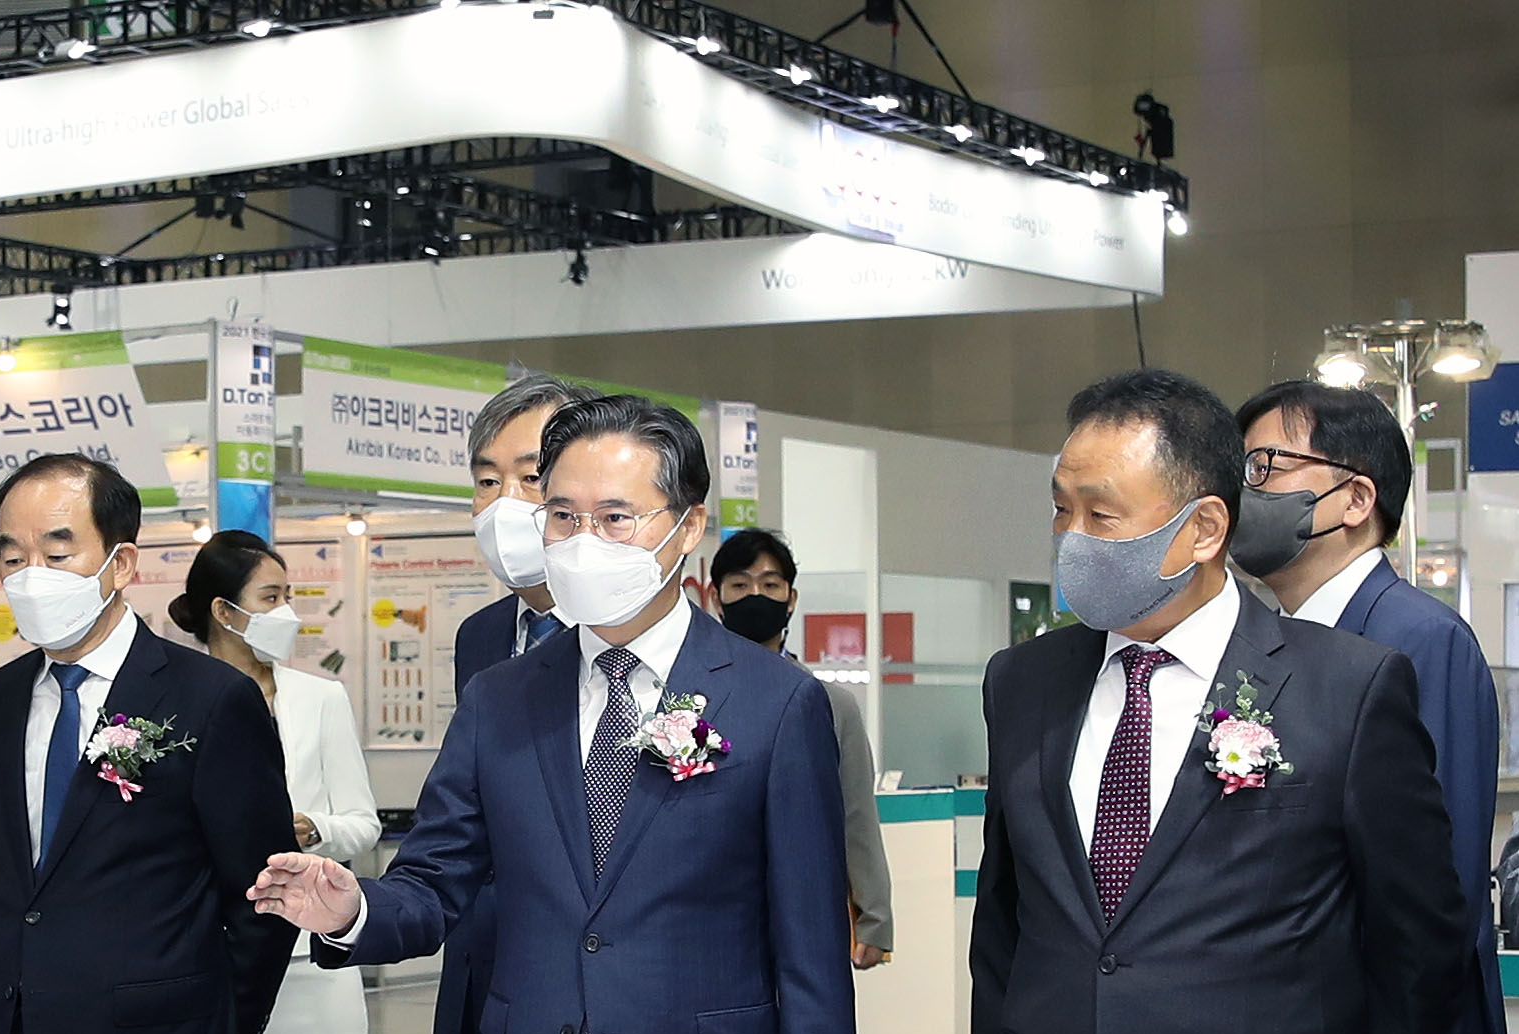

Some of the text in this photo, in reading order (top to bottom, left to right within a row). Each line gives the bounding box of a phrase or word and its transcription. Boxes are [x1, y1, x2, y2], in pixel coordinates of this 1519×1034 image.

[6, 117, 107, 149] Ultra-high
[183, 94, 252, 125] Global
[223, 388, 265, 405] D.Ton
[346, 437, 383, 458] Akribis
[386, 442, 421, 462] Korea
